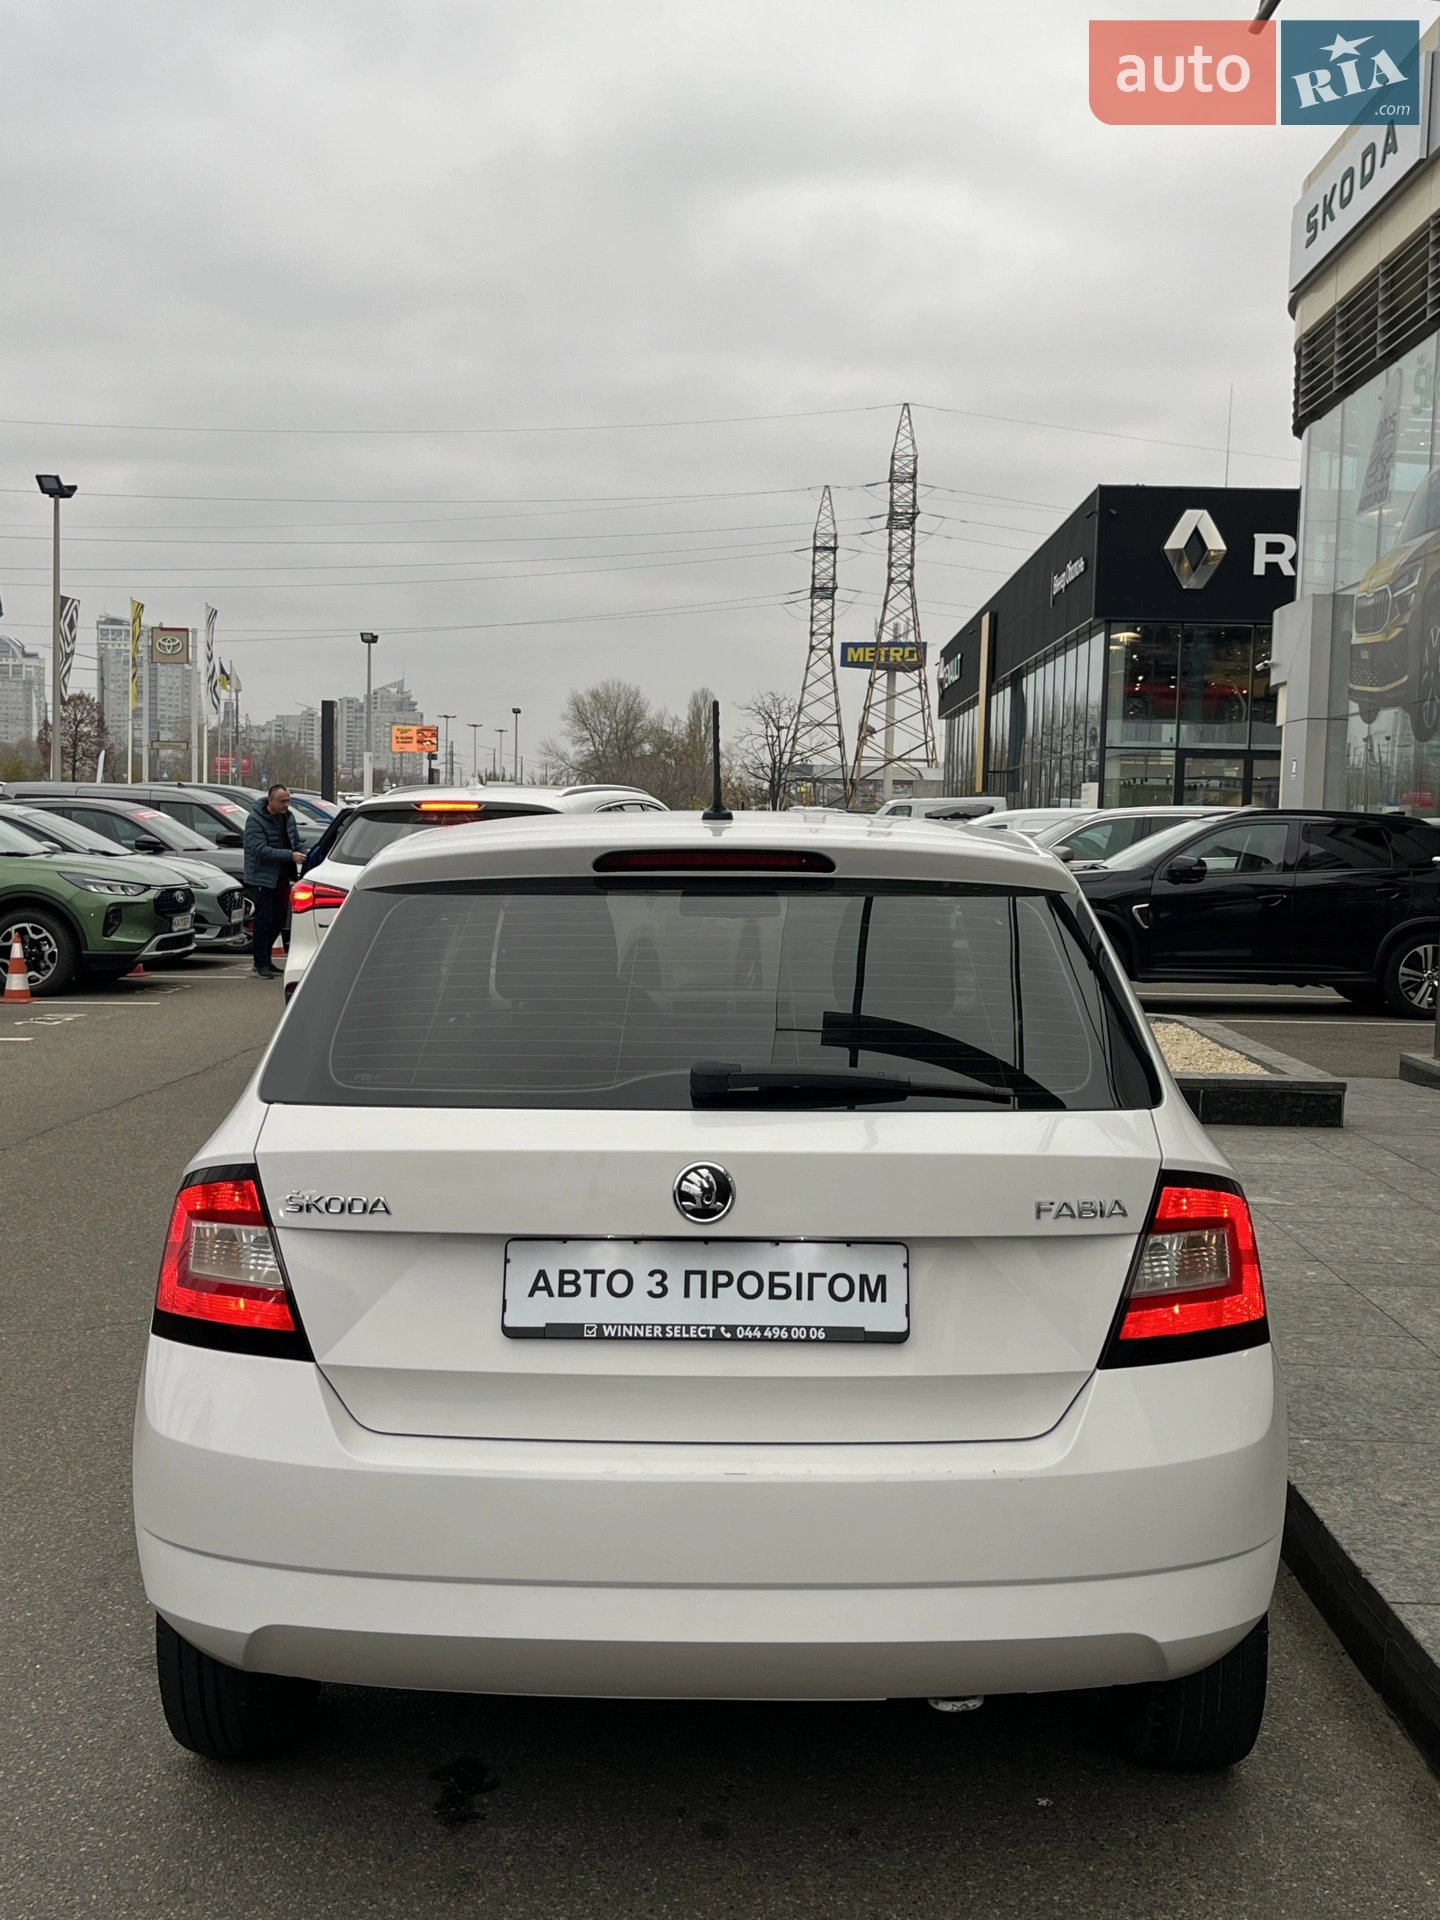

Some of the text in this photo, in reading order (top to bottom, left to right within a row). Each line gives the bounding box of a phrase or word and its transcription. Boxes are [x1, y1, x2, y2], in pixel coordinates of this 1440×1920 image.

[847, 647, 919, 662] METRO
[285, 1190, 392, 1215] ŠKODA
[1035, 1199, 1128, 1220] FABIA
[527, 1269, 634, 1298] АВТО
[683, 1270, 888, 1303] ПРОБІГОМ
[602, 1324, 826, 1340] WINNER SELECT 044 496 00 06
